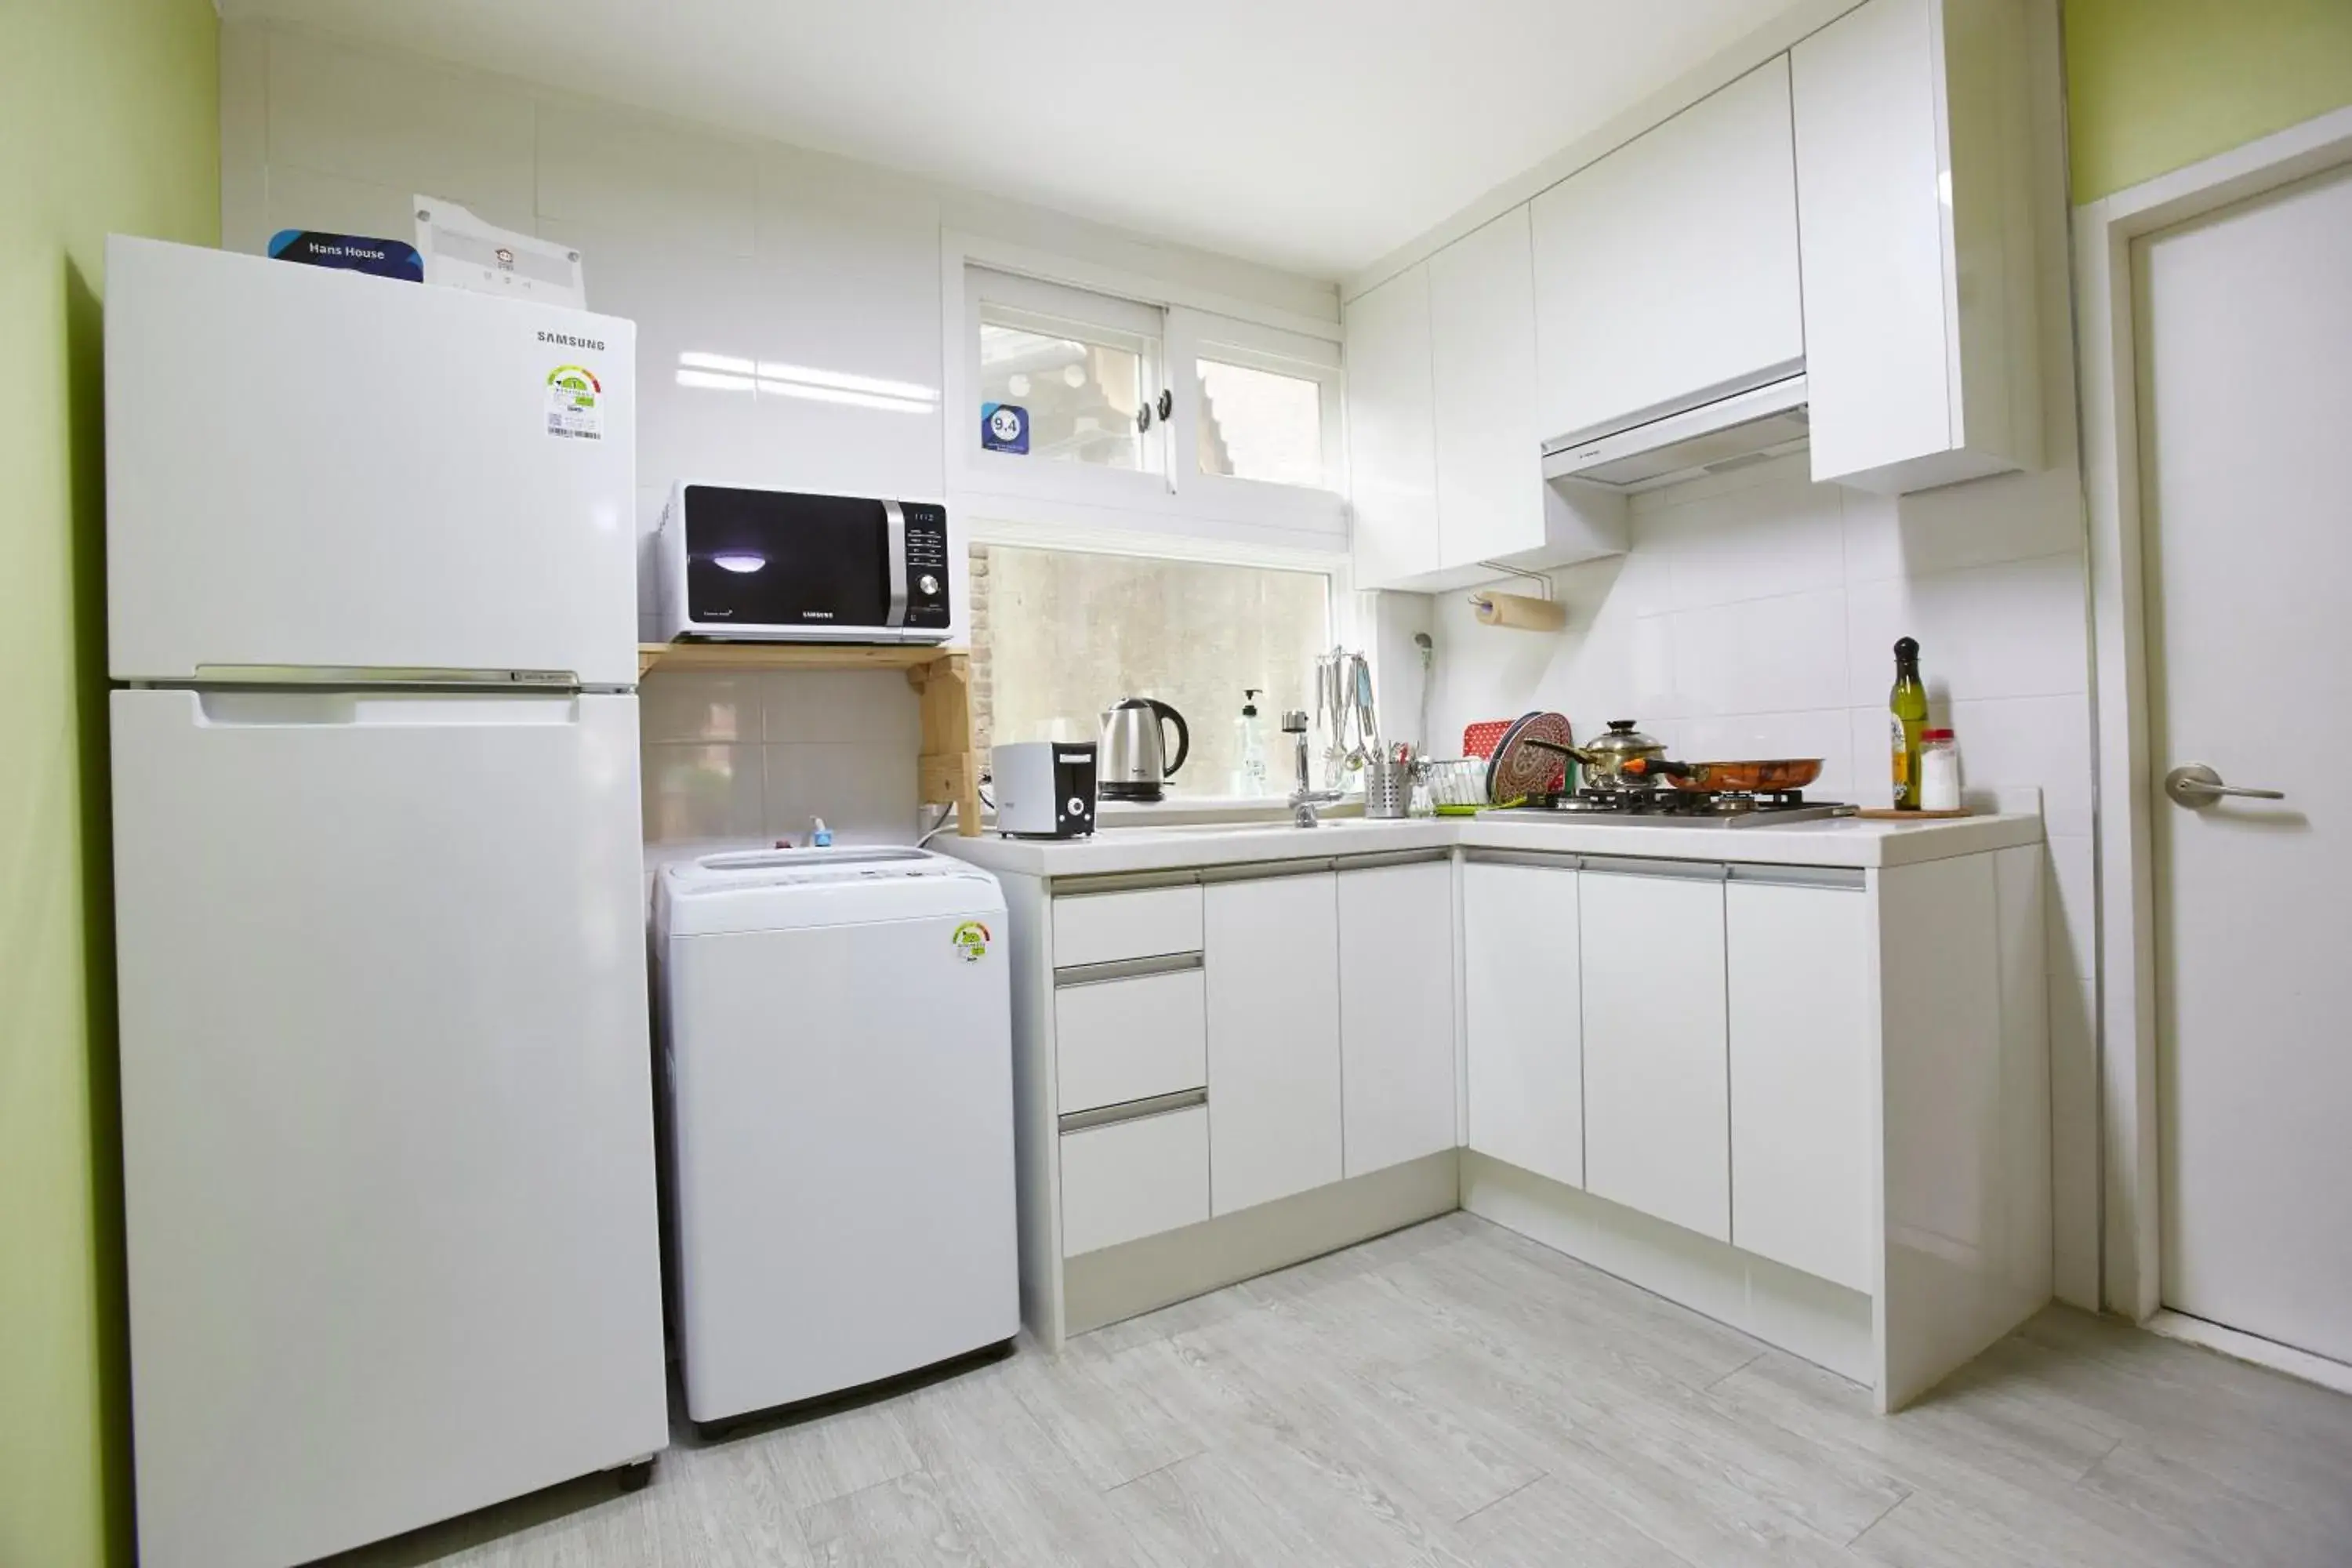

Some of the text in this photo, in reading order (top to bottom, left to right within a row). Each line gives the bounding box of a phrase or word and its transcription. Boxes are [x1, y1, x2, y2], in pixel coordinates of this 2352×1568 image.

[309, 242, 385, 260] Hans House
[537, 331, 606, 351] SAMSUNG
